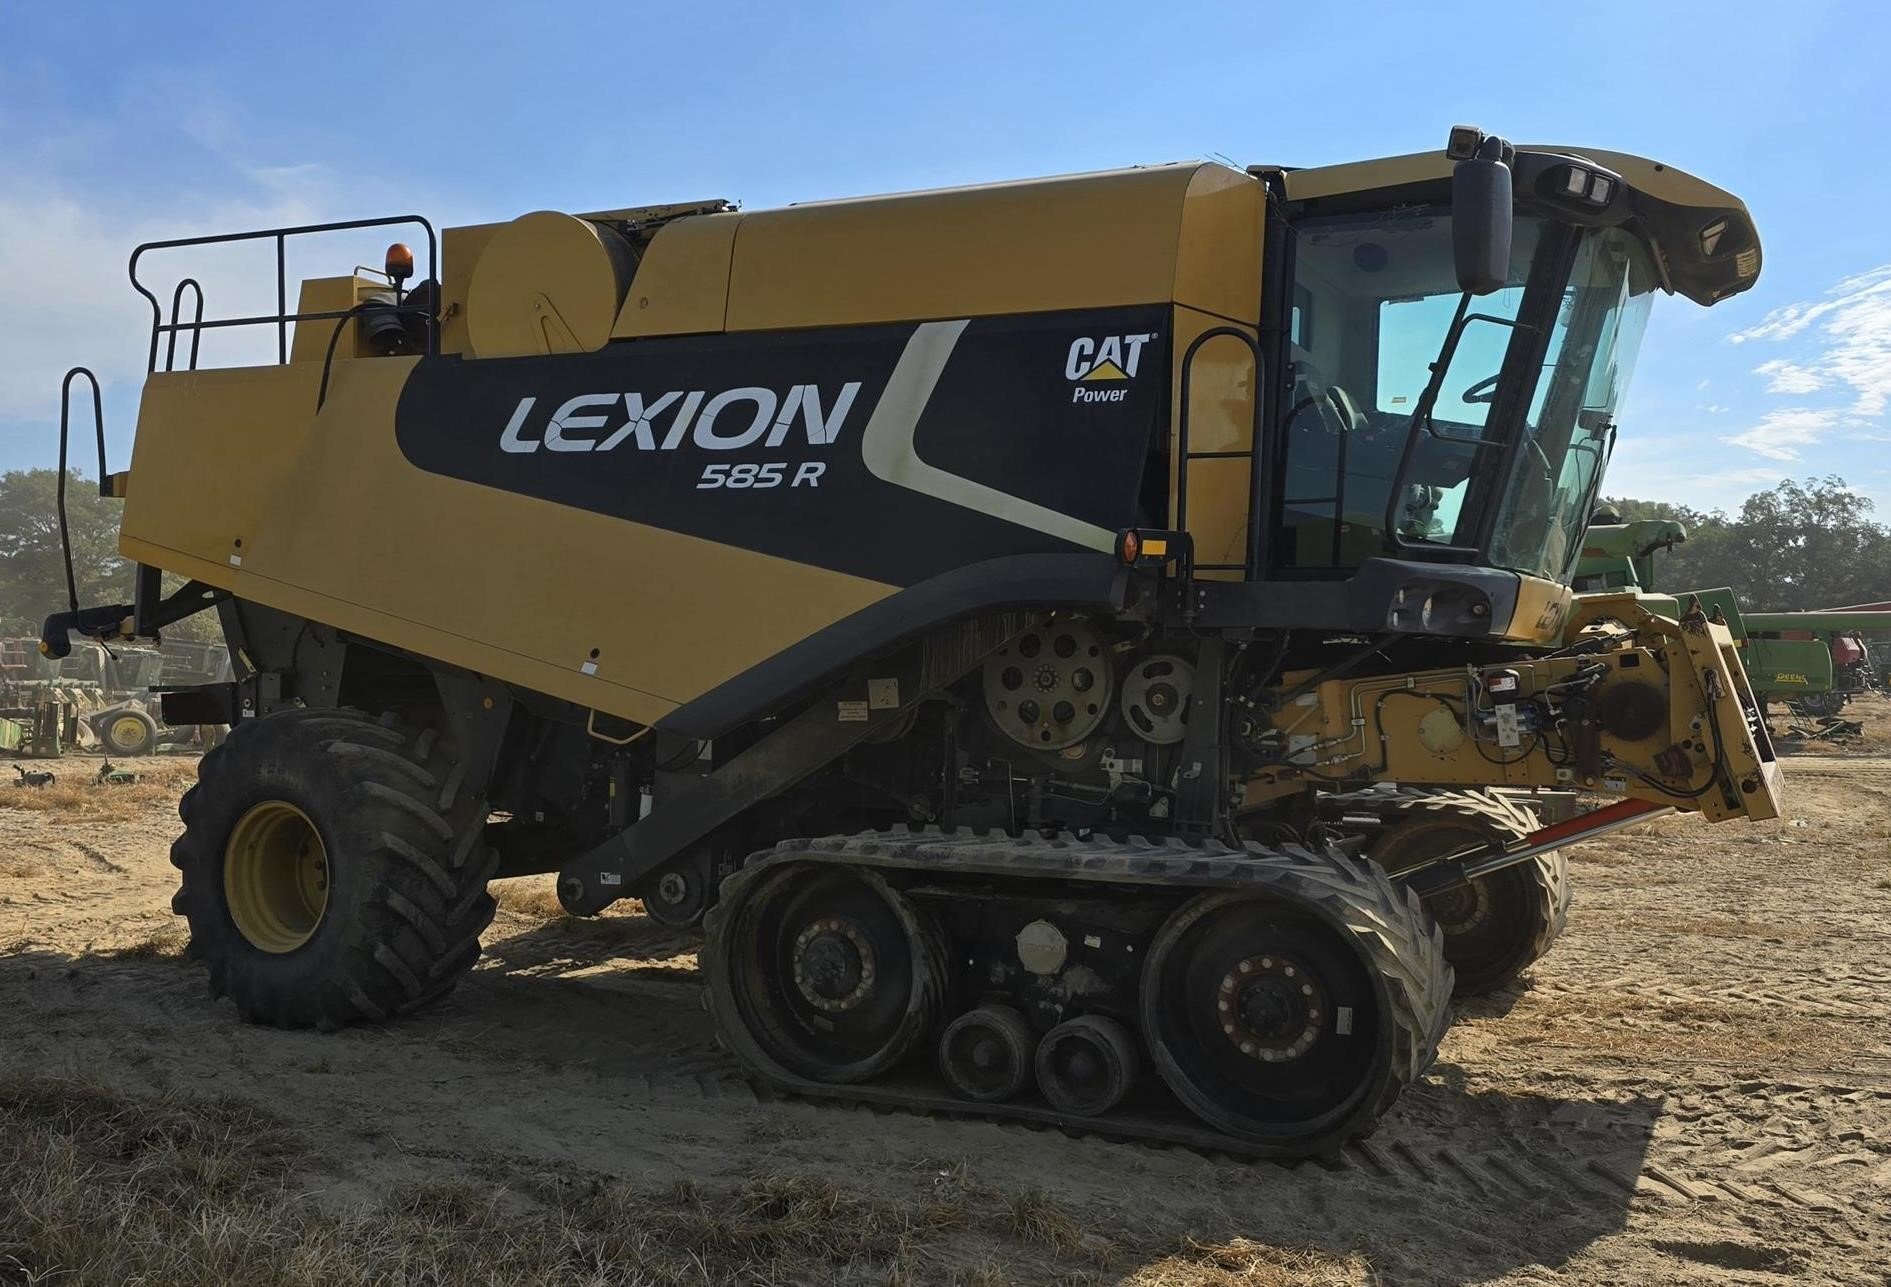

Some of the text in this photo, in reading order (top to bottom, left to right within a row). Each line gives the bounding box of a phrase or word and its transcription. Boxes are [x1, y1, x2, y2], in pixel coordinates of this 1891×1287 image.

[1072, 387, 1128, 403] Power
[499, 381, 863, 453] LEXION
[696, 461, 826, 489] 585 R
